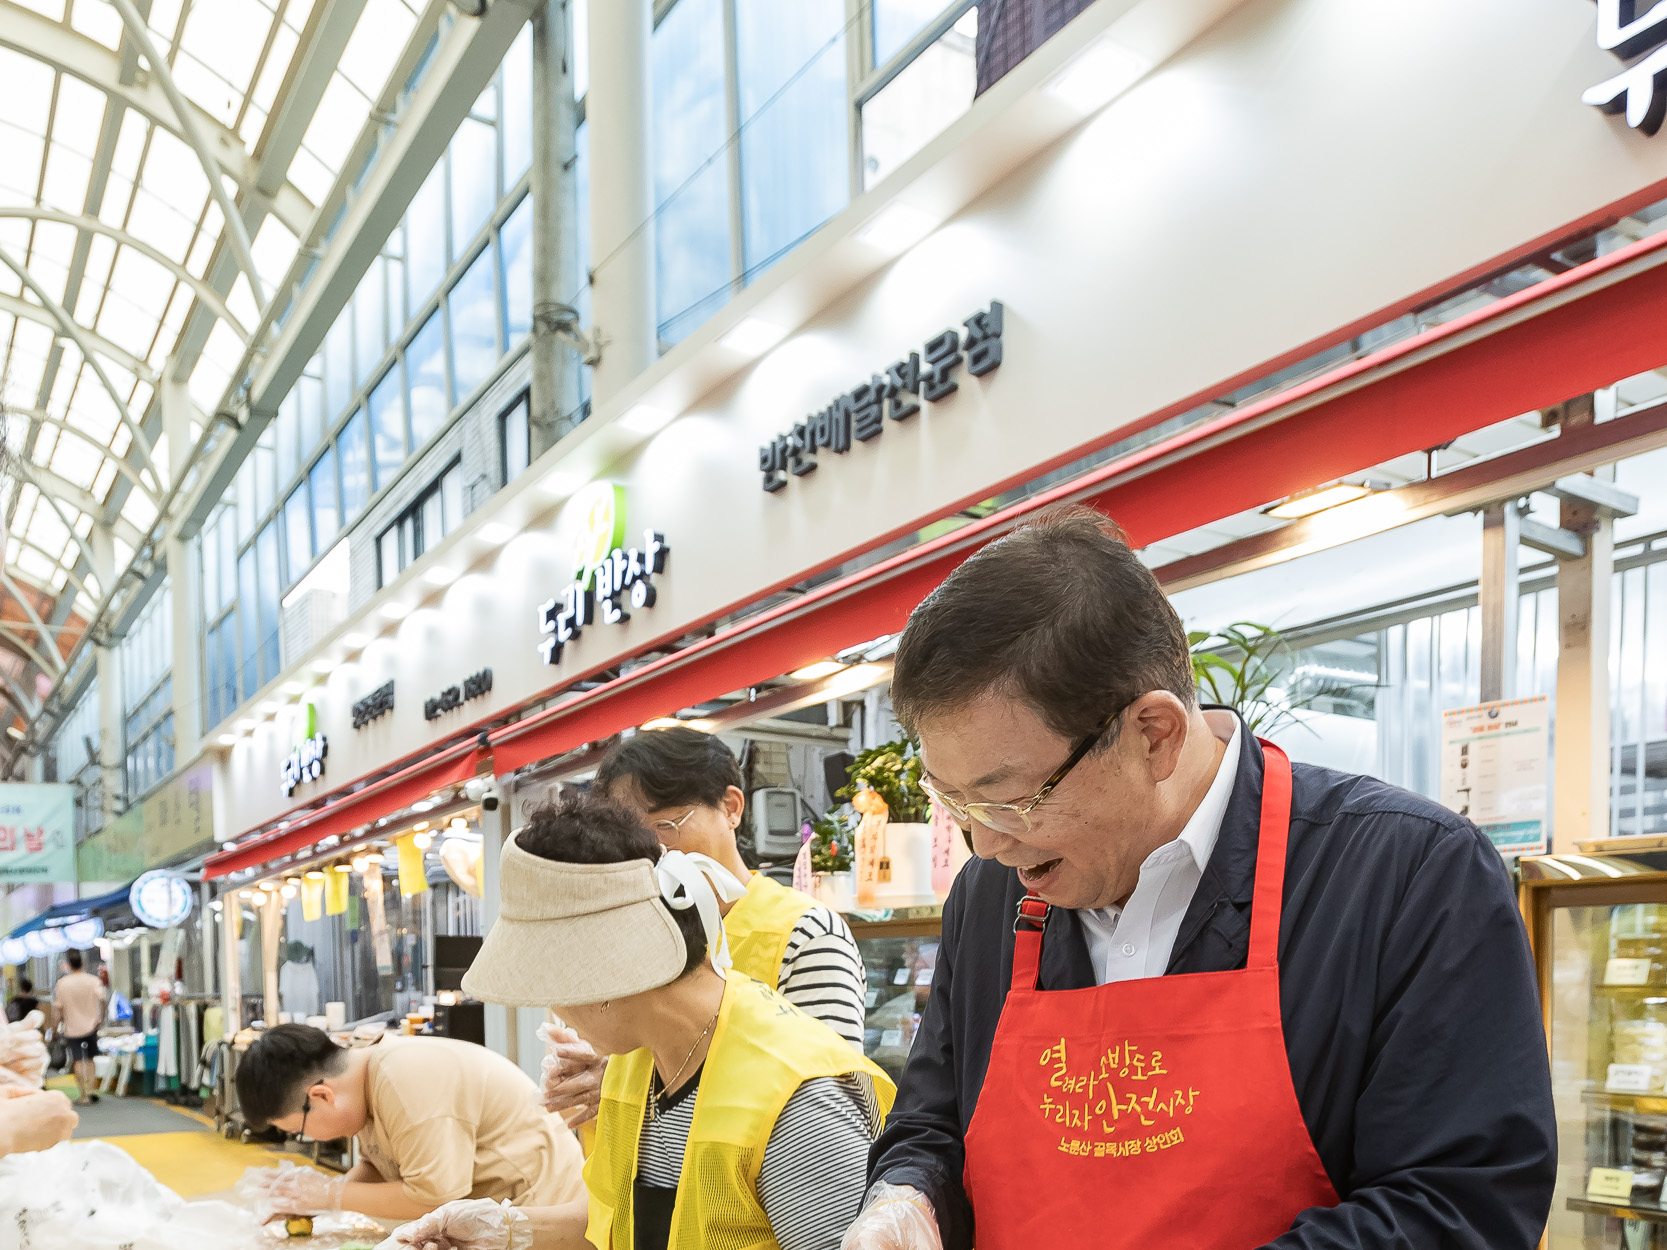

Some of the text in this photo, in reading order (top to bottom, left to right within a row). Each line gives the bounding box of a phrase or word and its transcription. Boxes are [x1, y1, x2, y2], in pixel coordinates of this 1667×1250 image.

[759, 300, 1004, 493] 반찬배달전문점
[1039, 1037, 1169, 1100] 열려라 소방도로
[1039, 1093, 1093, 1132] 누리자
[1093, 1139, 1142, 1158] 골목시장
[1144, 1126, 1185, 1153] 상인회
